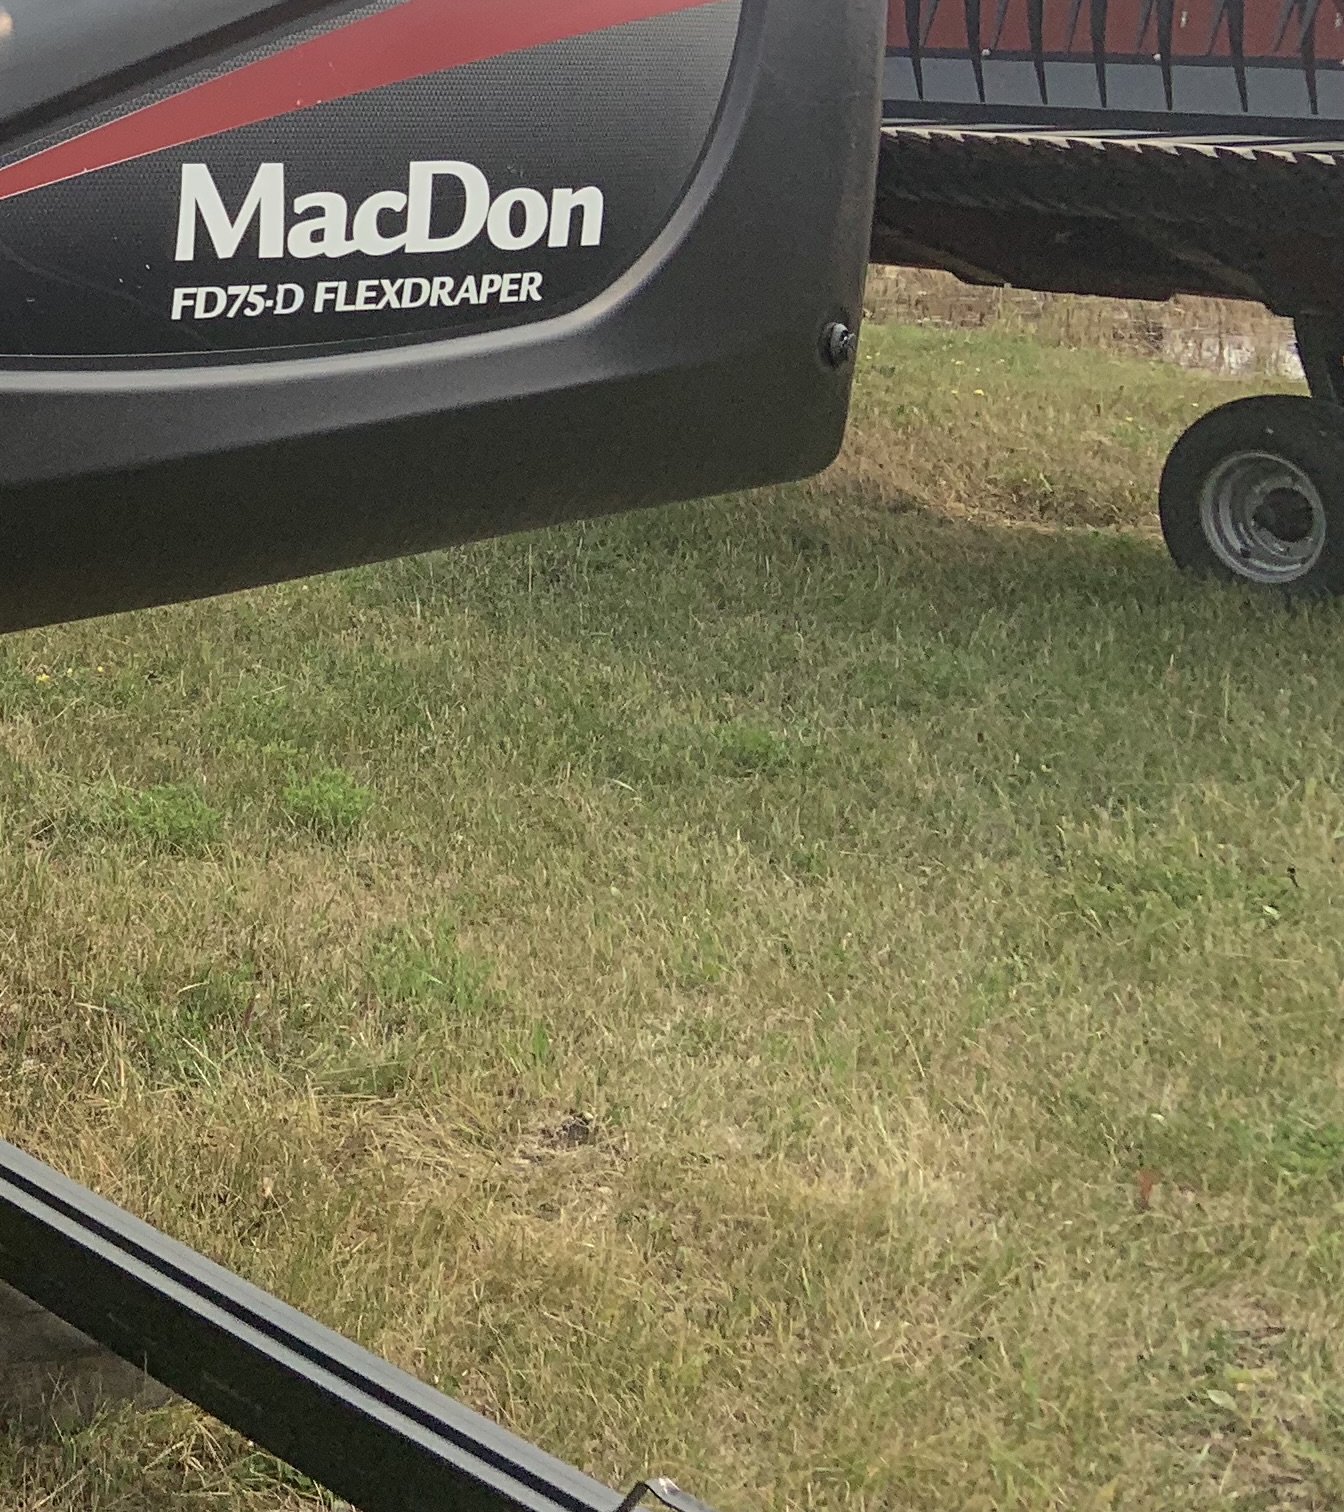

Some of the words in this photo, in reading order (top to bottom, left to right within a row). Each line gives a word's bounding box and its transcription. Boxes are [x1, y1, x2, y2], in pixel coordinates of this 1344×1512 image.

[174, 159, 604, 262] MacDon
[170, 283, 305, 320] FD75-D
[313, 271, 543, 313] FLEXDRAPER
